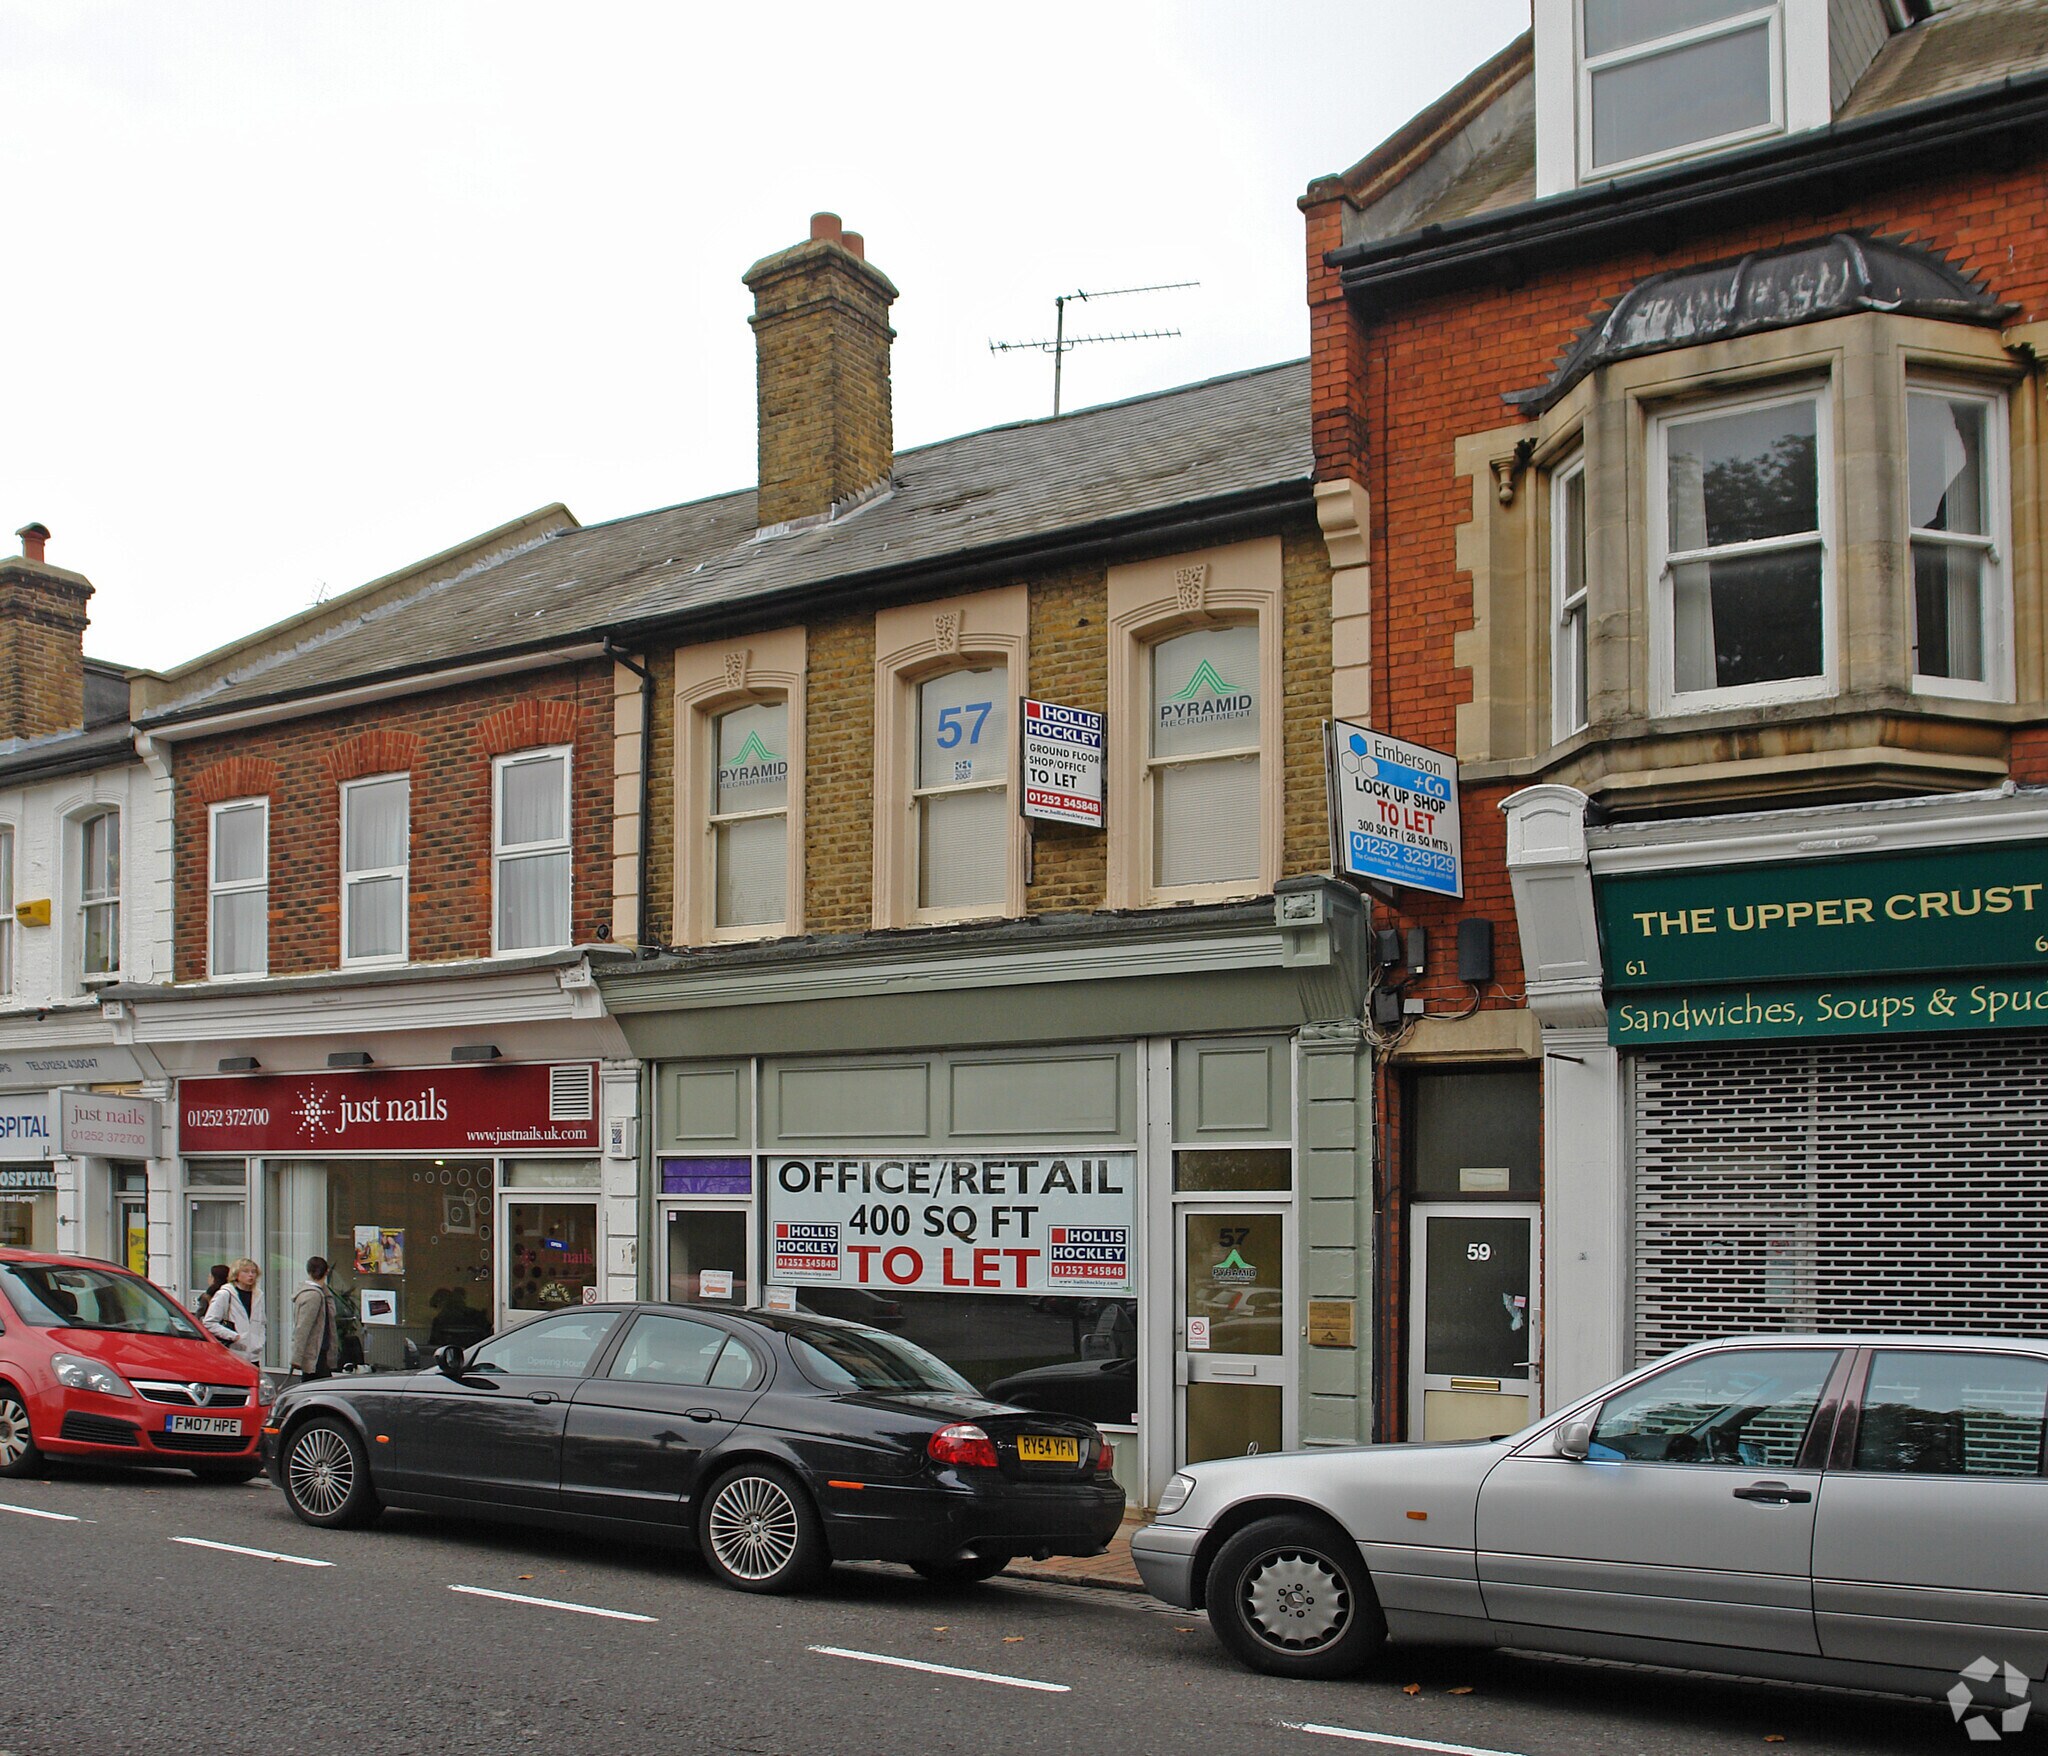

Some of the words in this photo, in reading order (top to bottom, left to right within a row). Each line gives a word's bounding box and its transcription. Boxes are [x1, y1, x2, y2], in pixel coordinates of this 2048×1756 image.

[1044, 706, 1099, 728] HOLLIS
[1160, 694, 1252, 720] PYRAMID
[937, 701, 992, 749] 57
[1160, 709, 1252, 728] RECRUITMENT
[1028, 721, 1098, 746] HOCKLEY
[1030, 743, 1070, 758] GROUND
[1072, 751, 1100, 764] FLOOR
[1374, 740, 1441, 776] Emberson
[720, 762, 788, 783] PYRAMID
[1029, 755, 1087, 774] SHOP/OFFICE
[720, 774, 787, 790] RECRUITMENT
[1029, 768, 1049, 784] TO
[1054, 772, 1078, 789] LET
[1413, 775, 1445, 797] +Co
[1028, 792, 1061, 806] 01252
[1063, 800, 1099, 813] 545848
[1355, 776, 1391, 800] LOCK
[1393, 788, 1410, 805] UP
[1413, 793, 1446, 814] SHOP
[1377, 800, 1399, 827] TO
[1404, 808, 1435, 836] LET
[1358, 819, 1374, 832] 300
[1376, 824, 1388, 838] SQ
[1389, 827, 1399, 839] FT
[1406, 832, 1416, 844] 28
[1418, 834, 1430, 848] SQ
[1432, 838, 1449, 852] MTS
[1352, 834, 1399, 860] 01252
[1403, 847, 1455, 874] 329129
[1632, 907, 1717, 937] THE
[1726, 898, 1874, 932] UPPER
[1884, 882, 2043, 921] CRUST
[1625, 960, 1648, 977] 61
[1619, 993, 1804, 1032] Sandwiches,
[1816, 992, 1915, 1026] Soups
[1928, 988, 1957, 1017] &
[0, 1063, 12, 1072] PS
[68, 1058, 98, 1069] 430047
[71, 1105, 102, 1125] just
[106, 1108, 145, 1126] nails
[188, 1108, 223, 1128] 01252
[225, 1107, 270, 1126] 372700
[335, 1094, 381, 1134] just
[386, 1088, 448, 1124] nails
[72, 1130, 104, 1142] 01252
[106, 1132, 145, 1145] 372700
[466, 1128, 588, 1145] www.justnails.uk.com
[778, 1160, 1124, 1198] OFFICE/RETAIL
[792, 1226, 836, 1238] HOLLIS
[849, 1204, 912, 1237] 400
[923, 1205, 978, 1244] SQ
[992, 1206, 1039, 1238] FT
[1070, 1230, 1124, 1242] HOLLIS
[1219, 1228, 1250, 1248] 57
[563, 1248, 593, 1264] nails
[777, 1241, 836, 1254] HOCKLEY
[1053, 1247, 1124, 1260] HOCKLEY
[1466, 1243, 1491, 1262] 59
[778, 1258, 803, 1266] 01252
[806, 1259, 836, 1268] 545848
[846, 1245, 924, 1286] TO
[943, 1247, 1041, 1288] LET
[1054, 1265, 1084, 1275] 01252
[1086, 1266, 1124, 1276] 545848
[1212, 1268, 1256, 1278] PYRAMID
[174, 1416, 211, 1432] FM07
[213, 1418, 237, 1433] HPE
[1024, 1438, 1052, 1455] RY54
[1054, 1439, 1074, 1456] YFN
